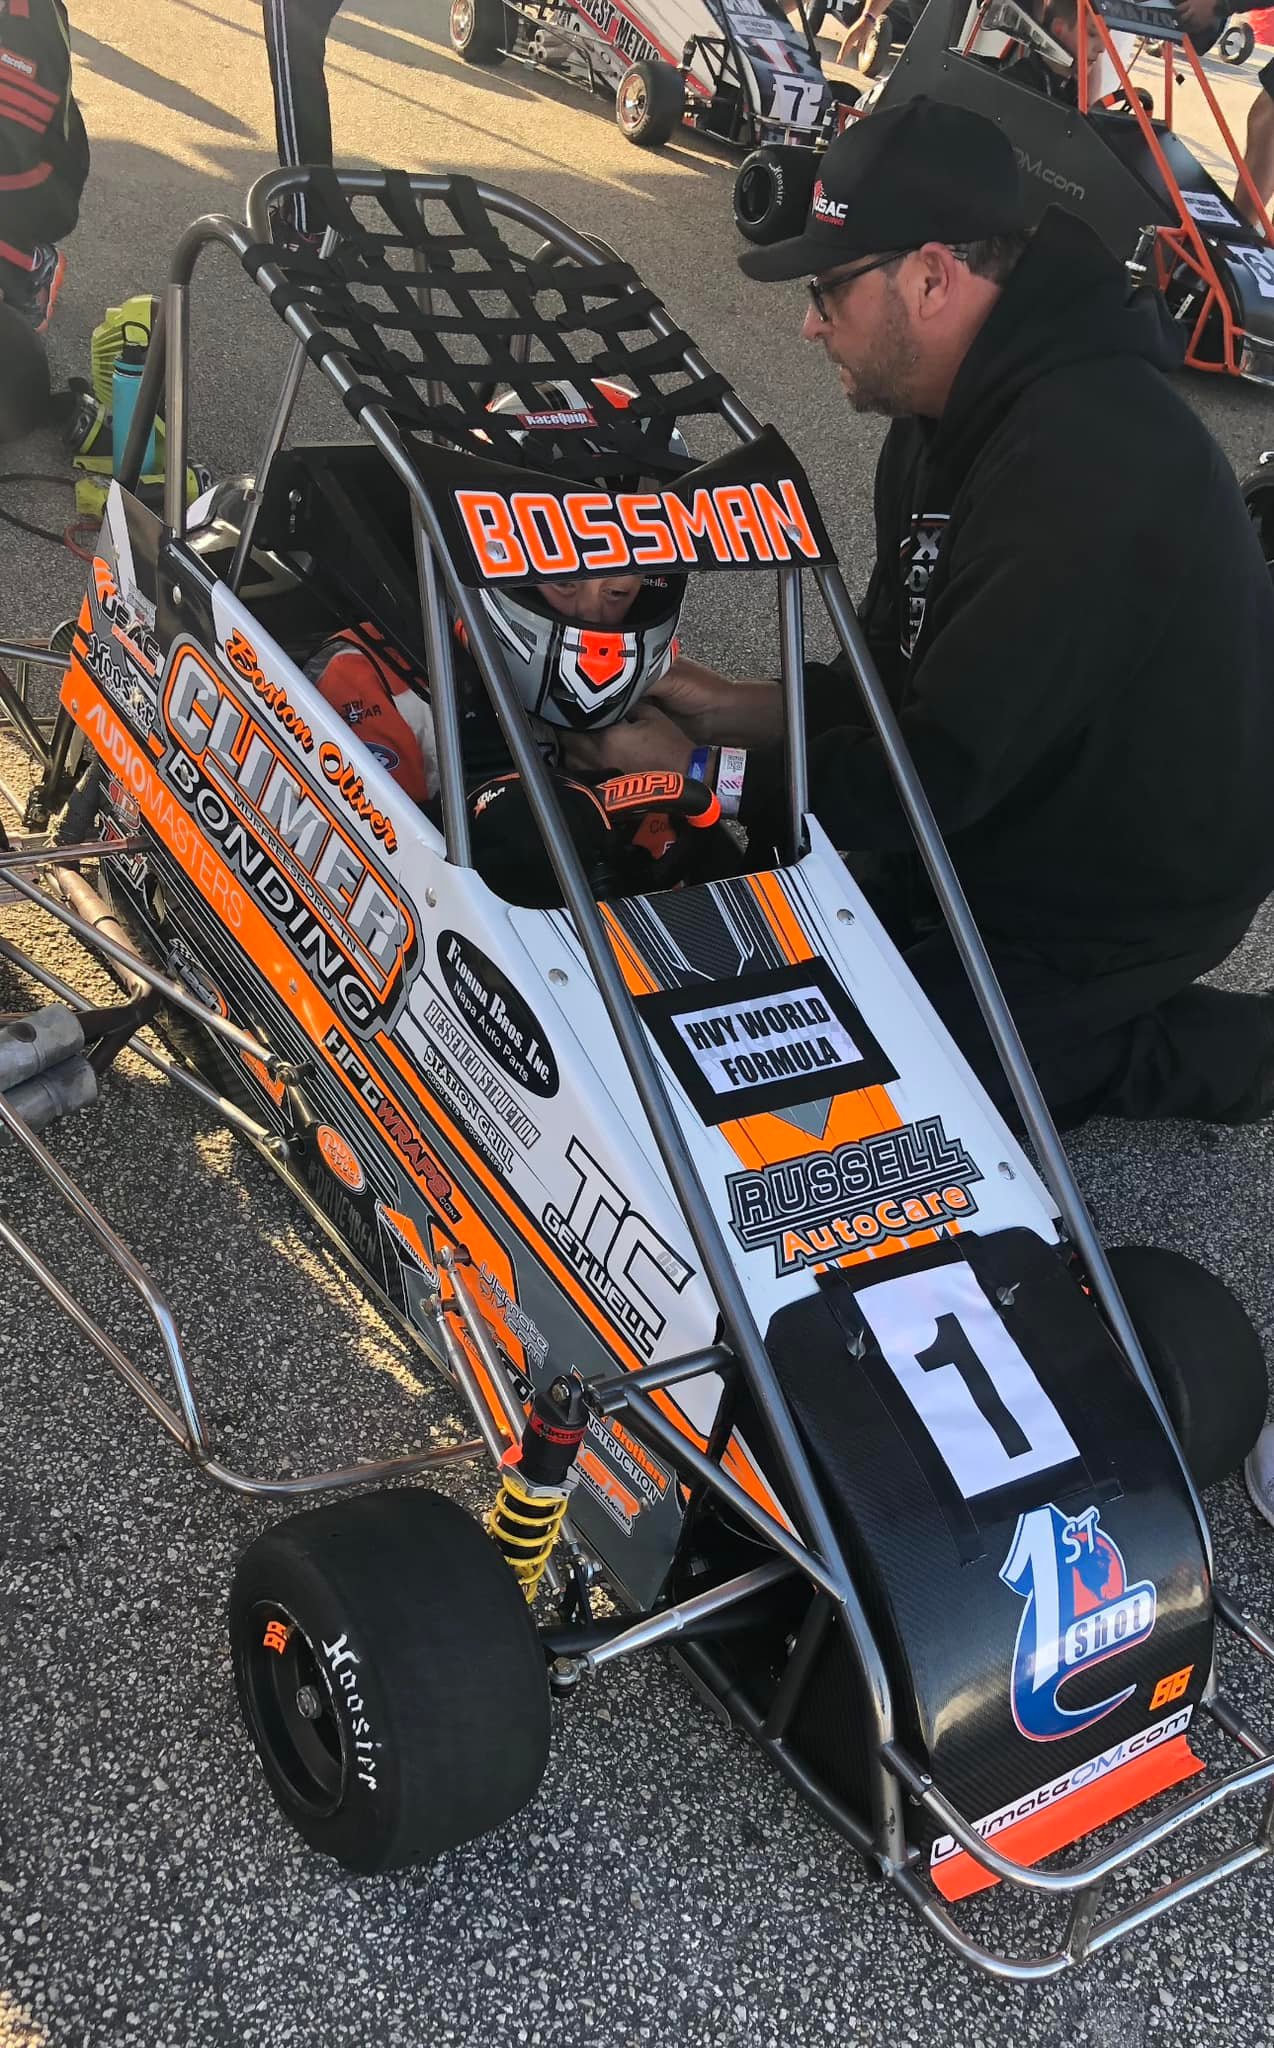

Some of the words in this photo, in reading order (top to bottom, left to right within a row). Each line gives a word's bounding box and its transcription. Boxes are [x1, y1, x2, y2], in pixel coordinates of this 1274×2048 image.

[814, 196, 848, 218] USAC
[524, 411, 588, 426] RaceQuip
[455, 478, 822, 579] BOSSMAN
[100, 591, 161, 670] USAC
[225, 628, 314, 753] Boston
[318, 741, 398, 855] Oliver
[85, 703, 245, 928] AUDIOMASTERS
[168, 656, 402, 974] CLIMER
[169, 750, 378, 1018] BONDING
[453, 980, 478, 1018] Napa
[477, 1014, 502, 1048] Auto
[503, 1044, 529, 1083] Parts
[684, 1014, 738, 1051] HVY
[736, 997, 831, 1039] WORLD
[720, 1036, 842, 1086] FORMULA
[424, 1045, 480, 1120] STATION
[478, 1114, 514, 1174] GRILL
[738, 1122, 959, 1228] RUSSELL
[781, 1185, 969, 1264] AutoCare
[913, 1311, 1034, 1460] 1
[586, 1411, 660, 1503] NSTRUCTION
[321, 1633, 383, 1791] Hoosier
